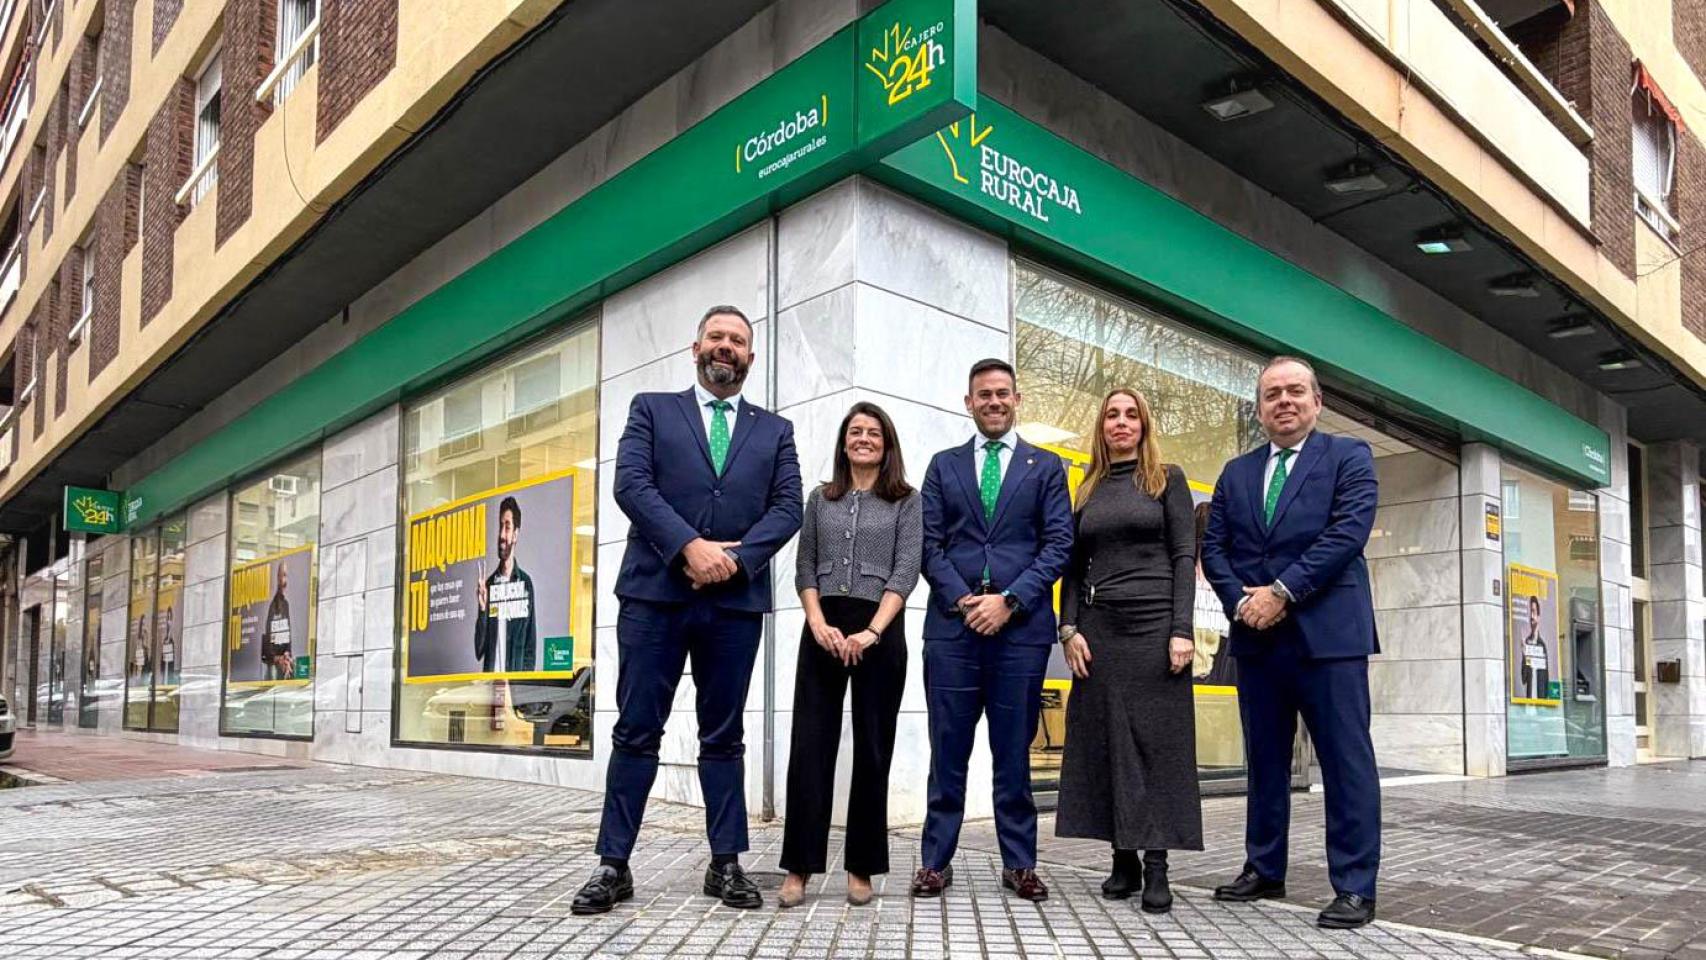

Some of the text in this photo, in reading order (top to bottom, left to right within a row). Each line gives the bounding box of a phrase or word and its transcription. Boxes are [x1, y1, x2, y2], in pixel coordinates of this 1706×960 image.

[904, 22, 944, 51] CAJERO
[888, 38, 946, 106] 24h
[980, 143, 1082, 215] EUROCAJA
[980, 169, 1049, 222] RURAL
[411, 503, 486, 573] MÁQUINA
[410, 570, 429, 632] TÚ
